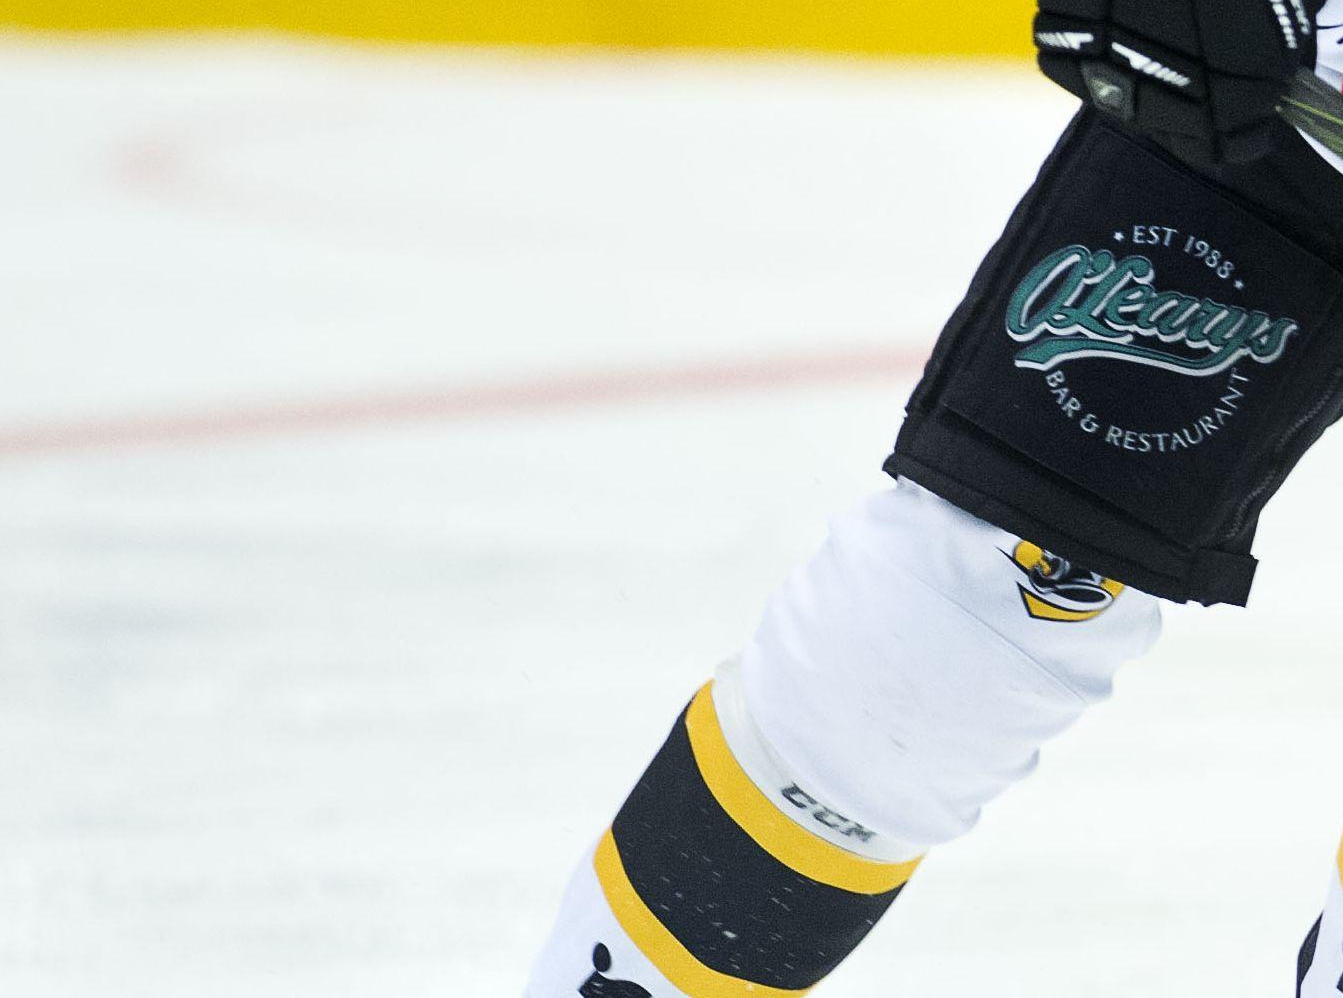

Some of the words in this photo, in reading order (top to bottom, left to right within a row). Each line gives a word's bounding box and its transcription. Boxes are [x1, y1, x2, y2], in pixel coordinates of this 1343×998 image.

[1132, 225, 1179, 247] EST
[1183, 235, 1237, 279] 1988
[1046, 370, 1082, 418] BAR
[1080, 413, 1100, 434] &
[1105, 368, 1250, 453] RESTAURANT
[781, 782, 880, 843] CCM
